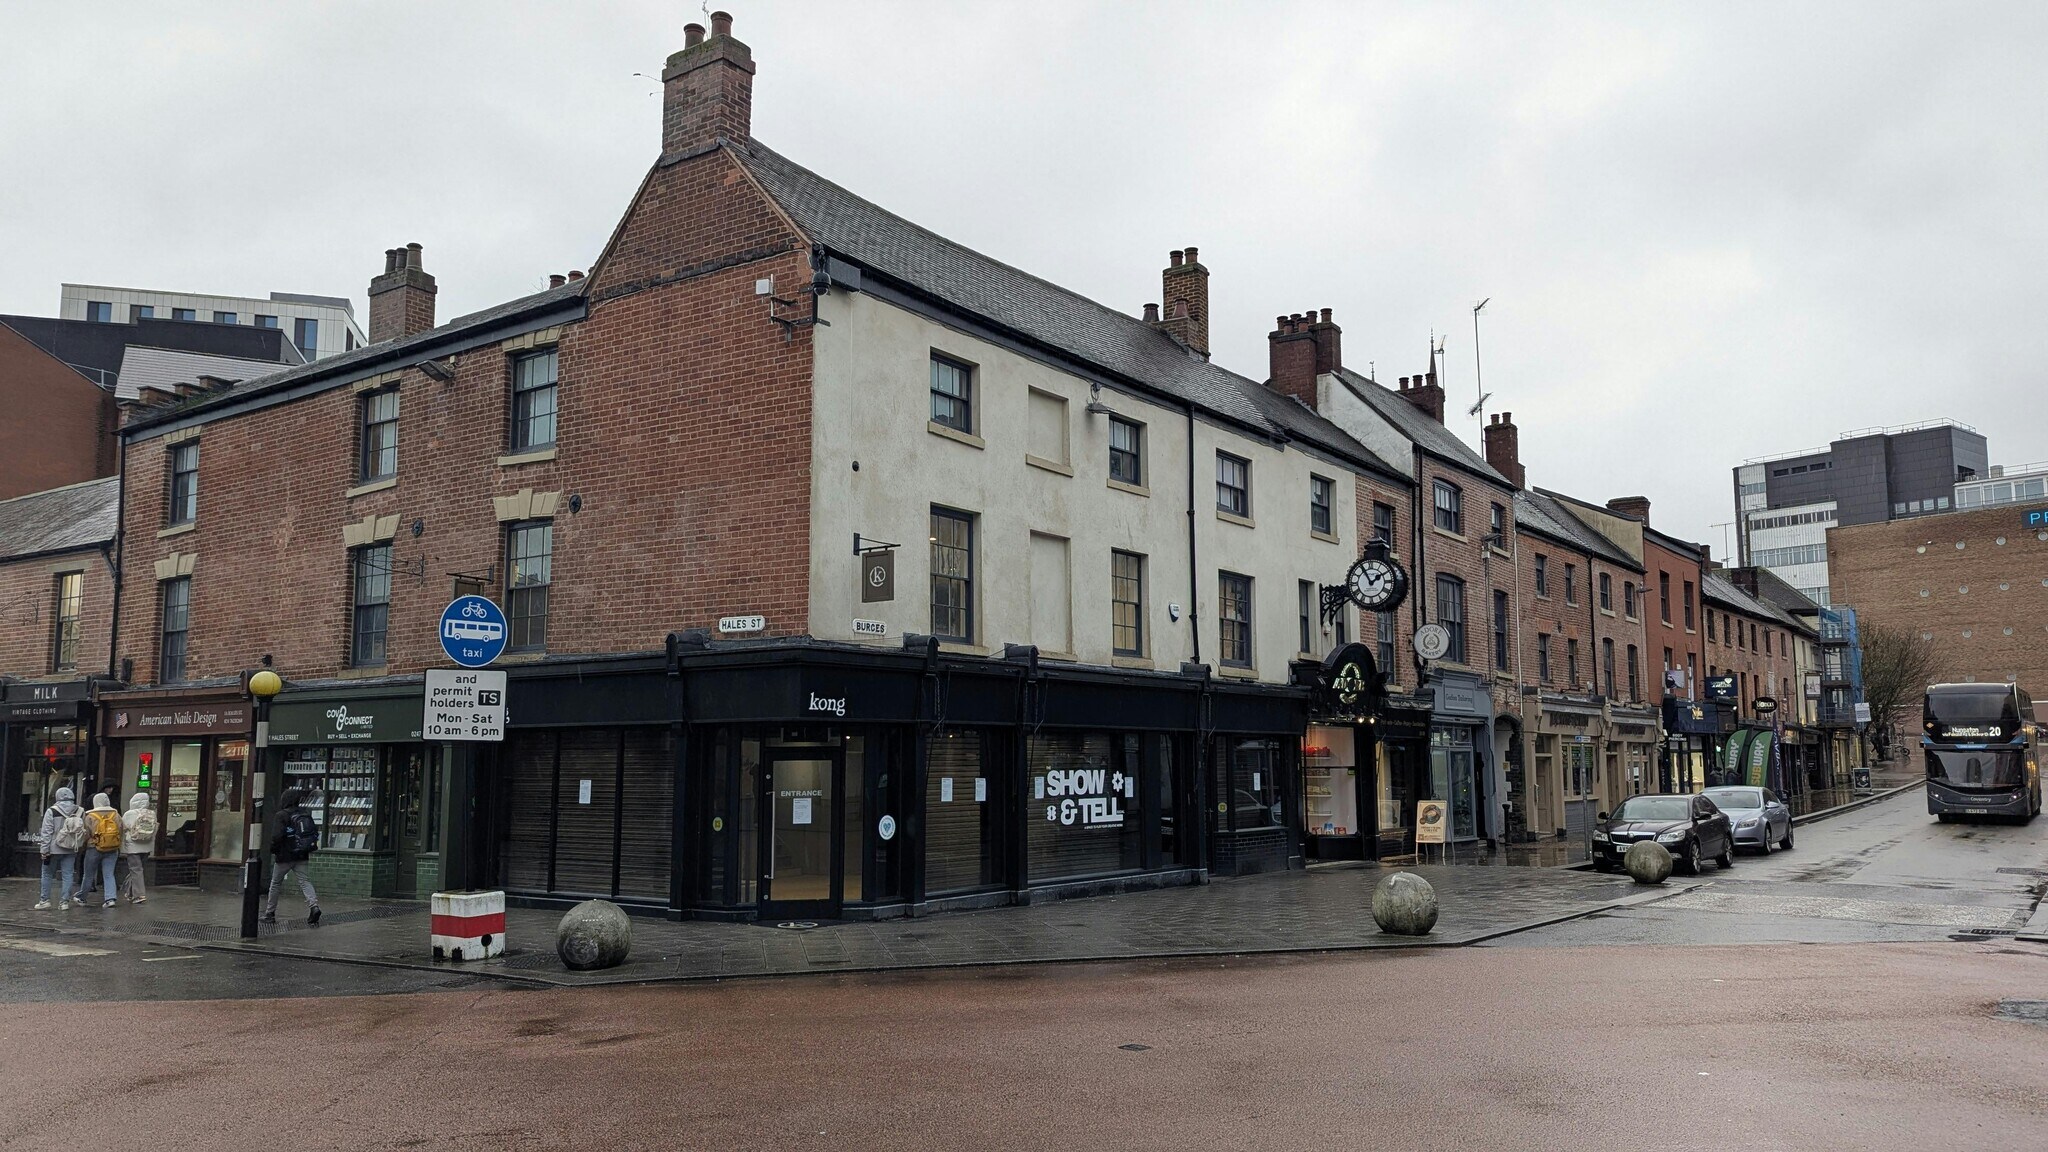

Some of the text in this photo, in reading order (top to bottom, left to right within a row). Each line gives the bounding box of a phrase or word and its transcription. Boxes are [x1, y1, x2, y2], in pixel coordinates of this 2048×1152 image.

[721, 618, 762, 630] HALES ST
[462, 647, 483, 658] taxi
[1421, 648, 1442, 656] BAKERY
[455, 674, 477, 684] and
[34, 687, 58, 700] MILK
[433, 686, 473, 697] permit
[430, 698, 474, 708] holders
[480, 692, 498, 704] TS
[808, 691, 846, 716] kong
[139, 713, 172, 726] American
[173, 711, 192, 725] Nails
[193, 711, 217, 728] Design
[344, 715, 373, 725] CONNECT
[436, 712, 462, 723] Mon
[471, 713, 493, 724] Sat
[428, 725, 442, 735] 10
[444, 727, 462, 735] am
[471, 725, 479, 735] 6
[481, 727, 499, 737] pm
[1989, 726, 2001, 737] 20
[1751, 739, 1765, 785] SUBWAY
[1046, 769, 1106, 796] SHOW
[1060, 796, 1124, 826] & TELL
